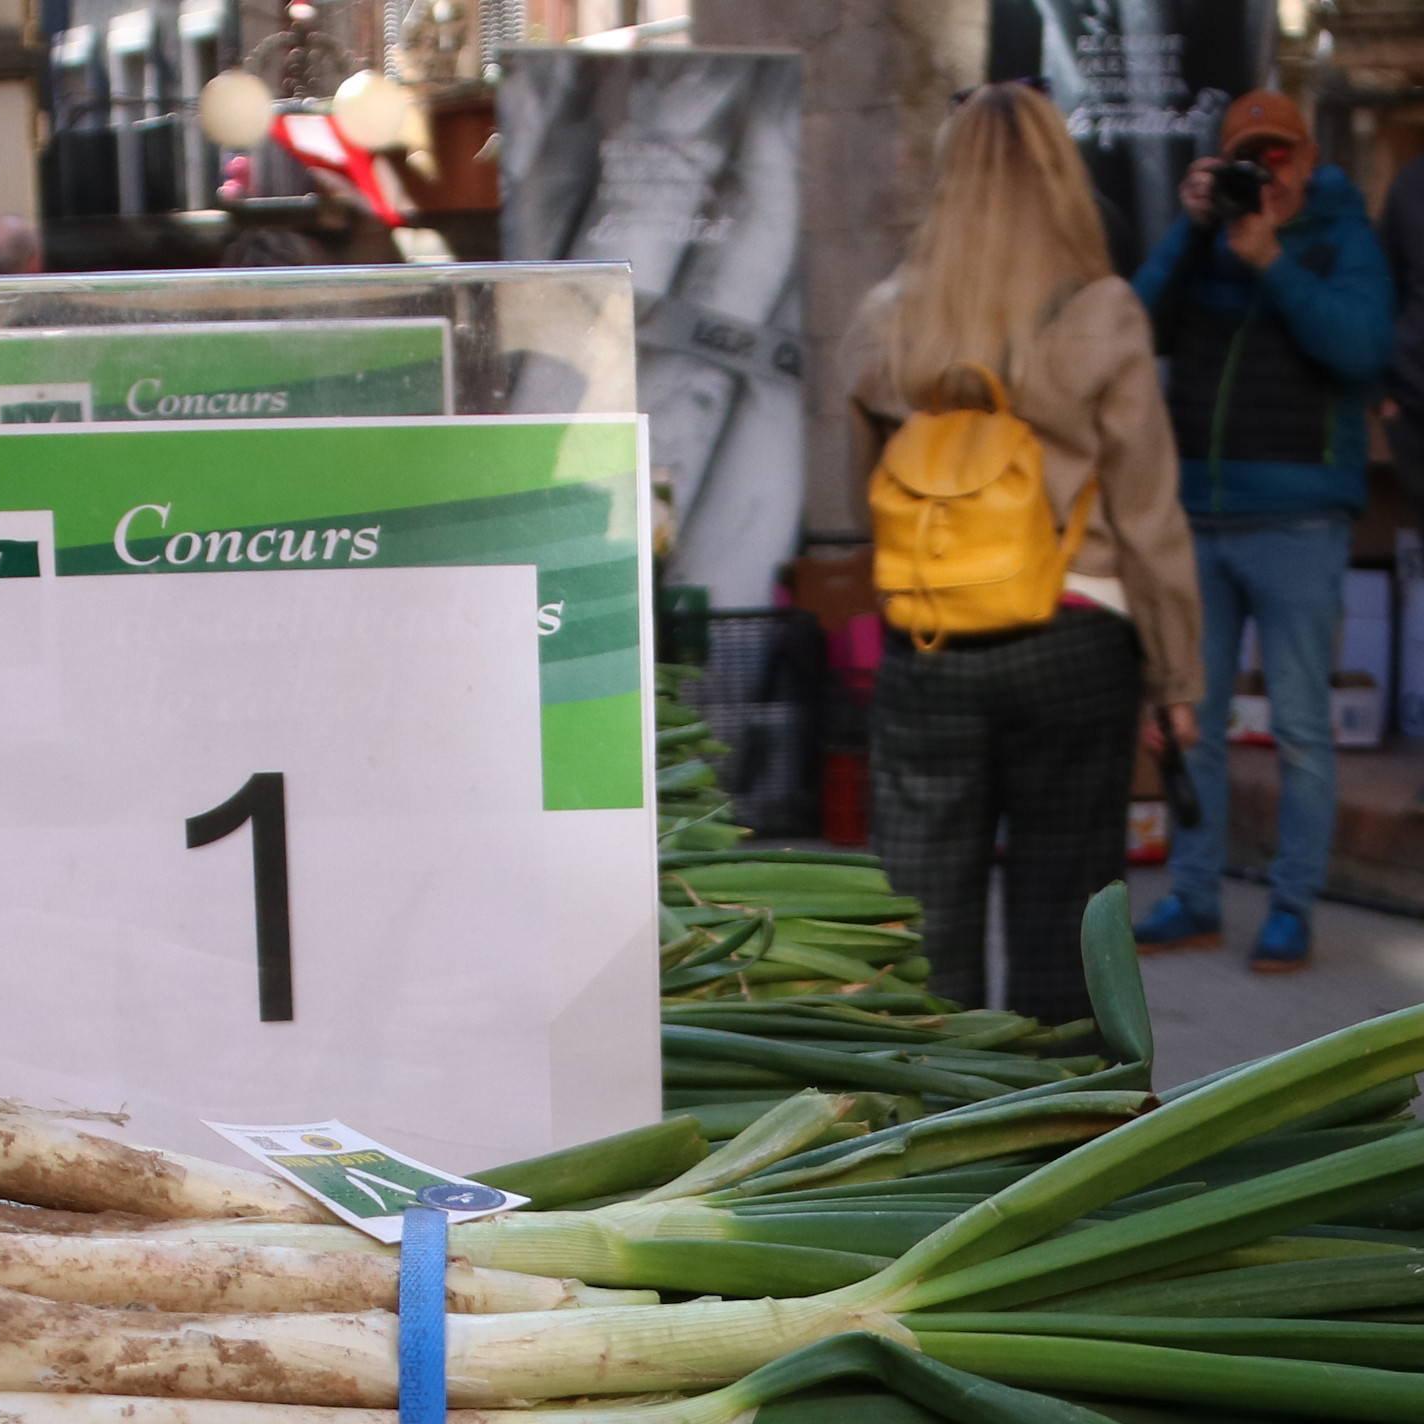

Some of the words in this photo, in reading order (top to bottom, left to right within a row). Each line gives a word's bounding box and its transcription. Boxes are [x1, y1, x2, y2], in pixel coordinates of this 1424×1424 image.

[127, 378, 289, 416] Concurs
[113, 502, 381, 566] Concurs
[185, 771, 294, 1023] 1
